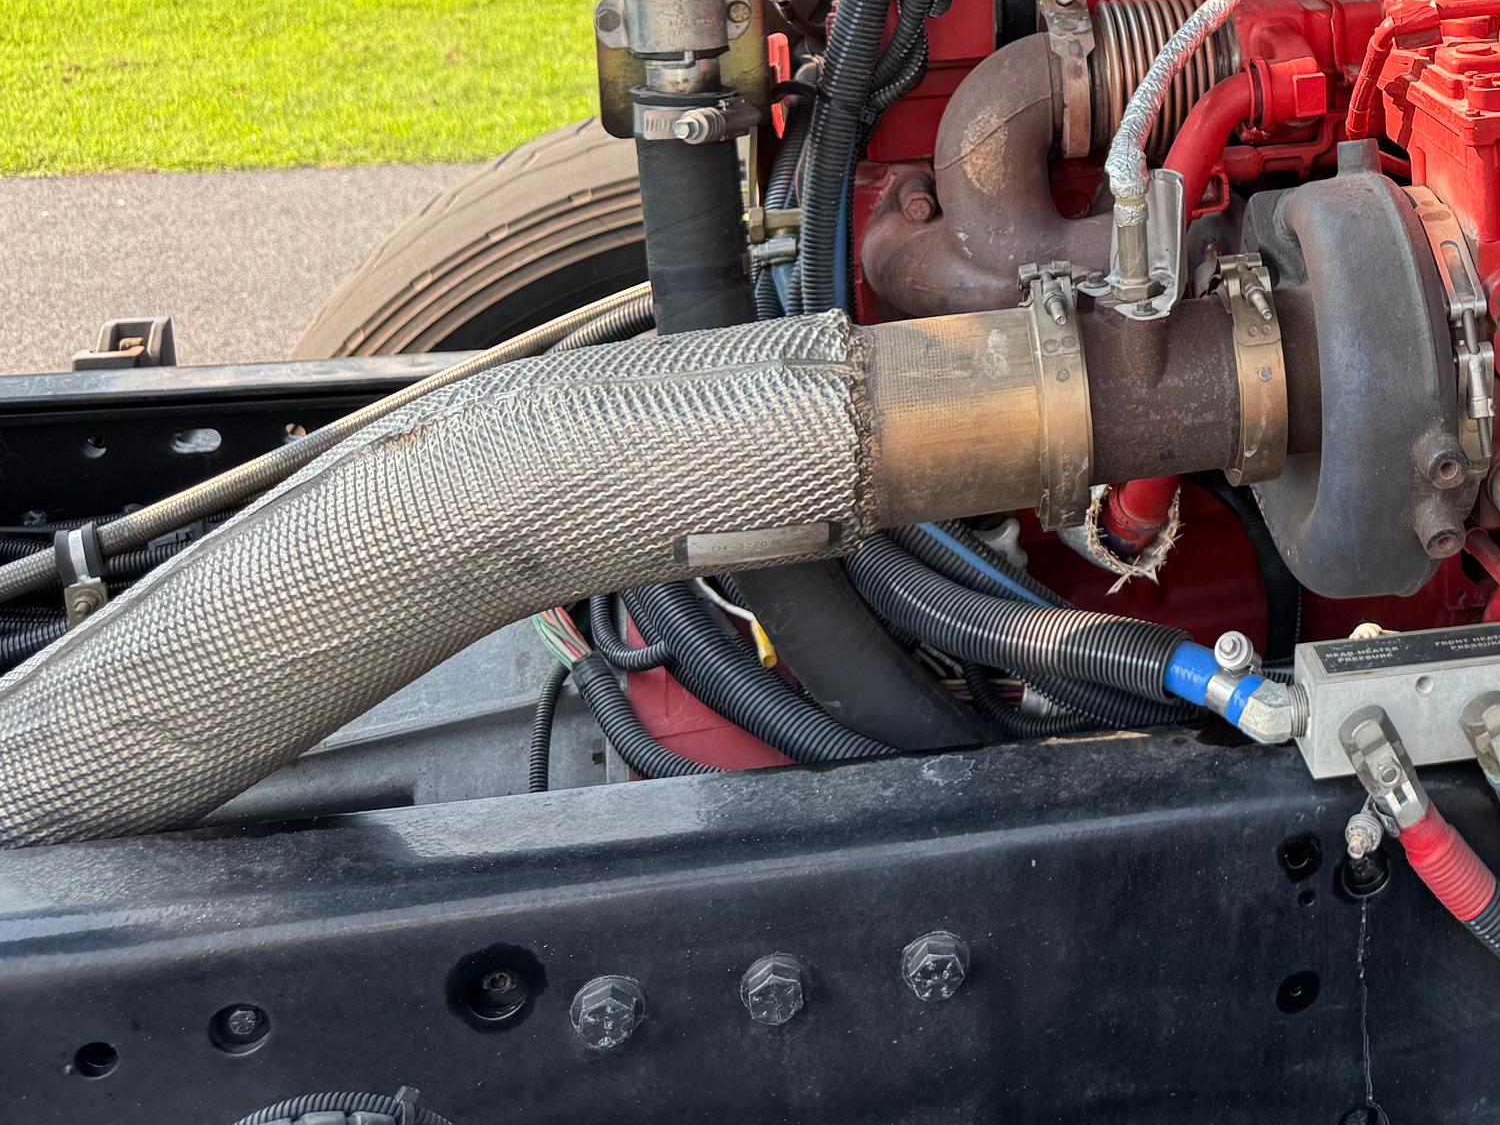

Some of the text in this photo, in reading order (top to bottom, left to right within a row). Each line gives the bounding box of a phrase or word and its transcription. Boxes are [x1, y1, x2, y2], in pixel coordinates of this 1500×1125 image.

[1434, 638, 1468, 647] FRONT
[1325, 646, 1399, 658] REAR HEATER
